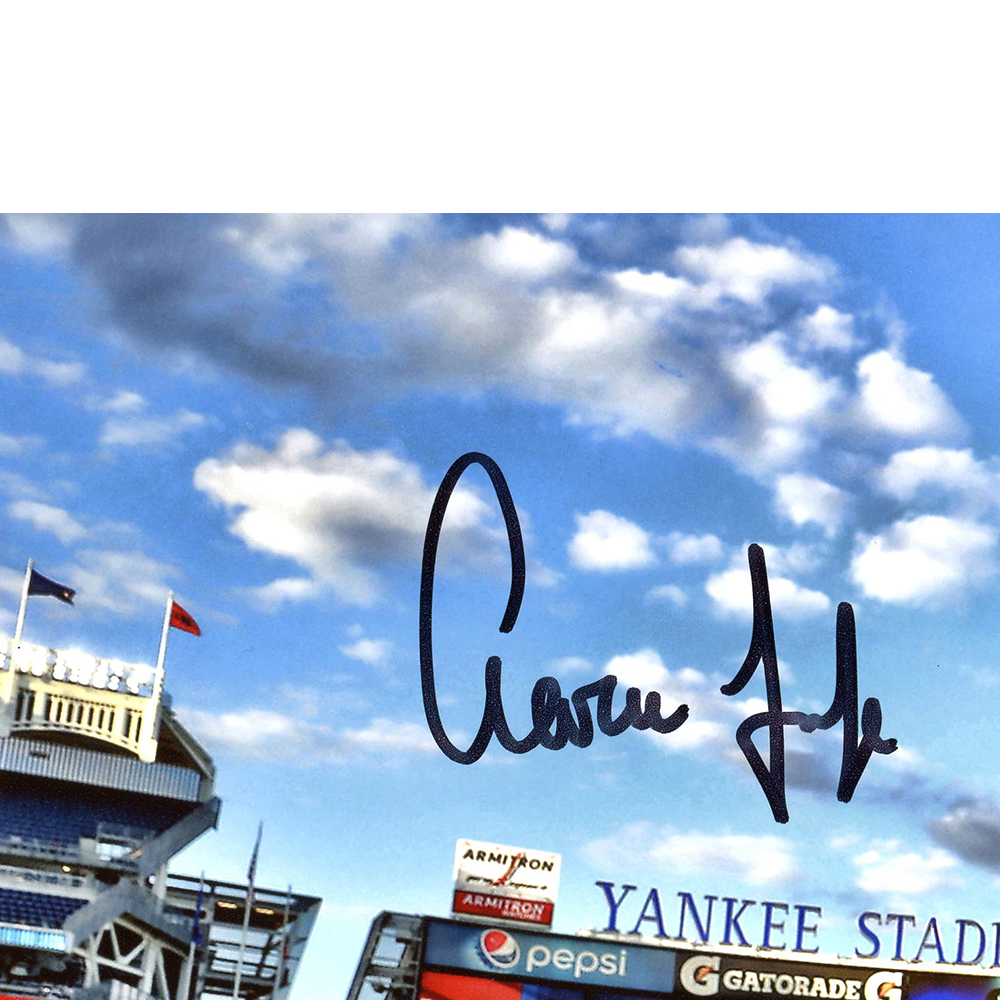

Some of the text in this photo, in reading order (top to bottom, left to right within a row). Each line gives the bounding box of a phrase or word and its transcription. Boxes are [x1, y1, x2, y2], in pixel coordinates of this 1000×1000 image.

[463, 894, 544, 915] ARMITRON
[595, 881, 822, 953] YANKEE
[526, 945, 626, 978] pepsi
[722, 970, 862, 1000] GATORADE
